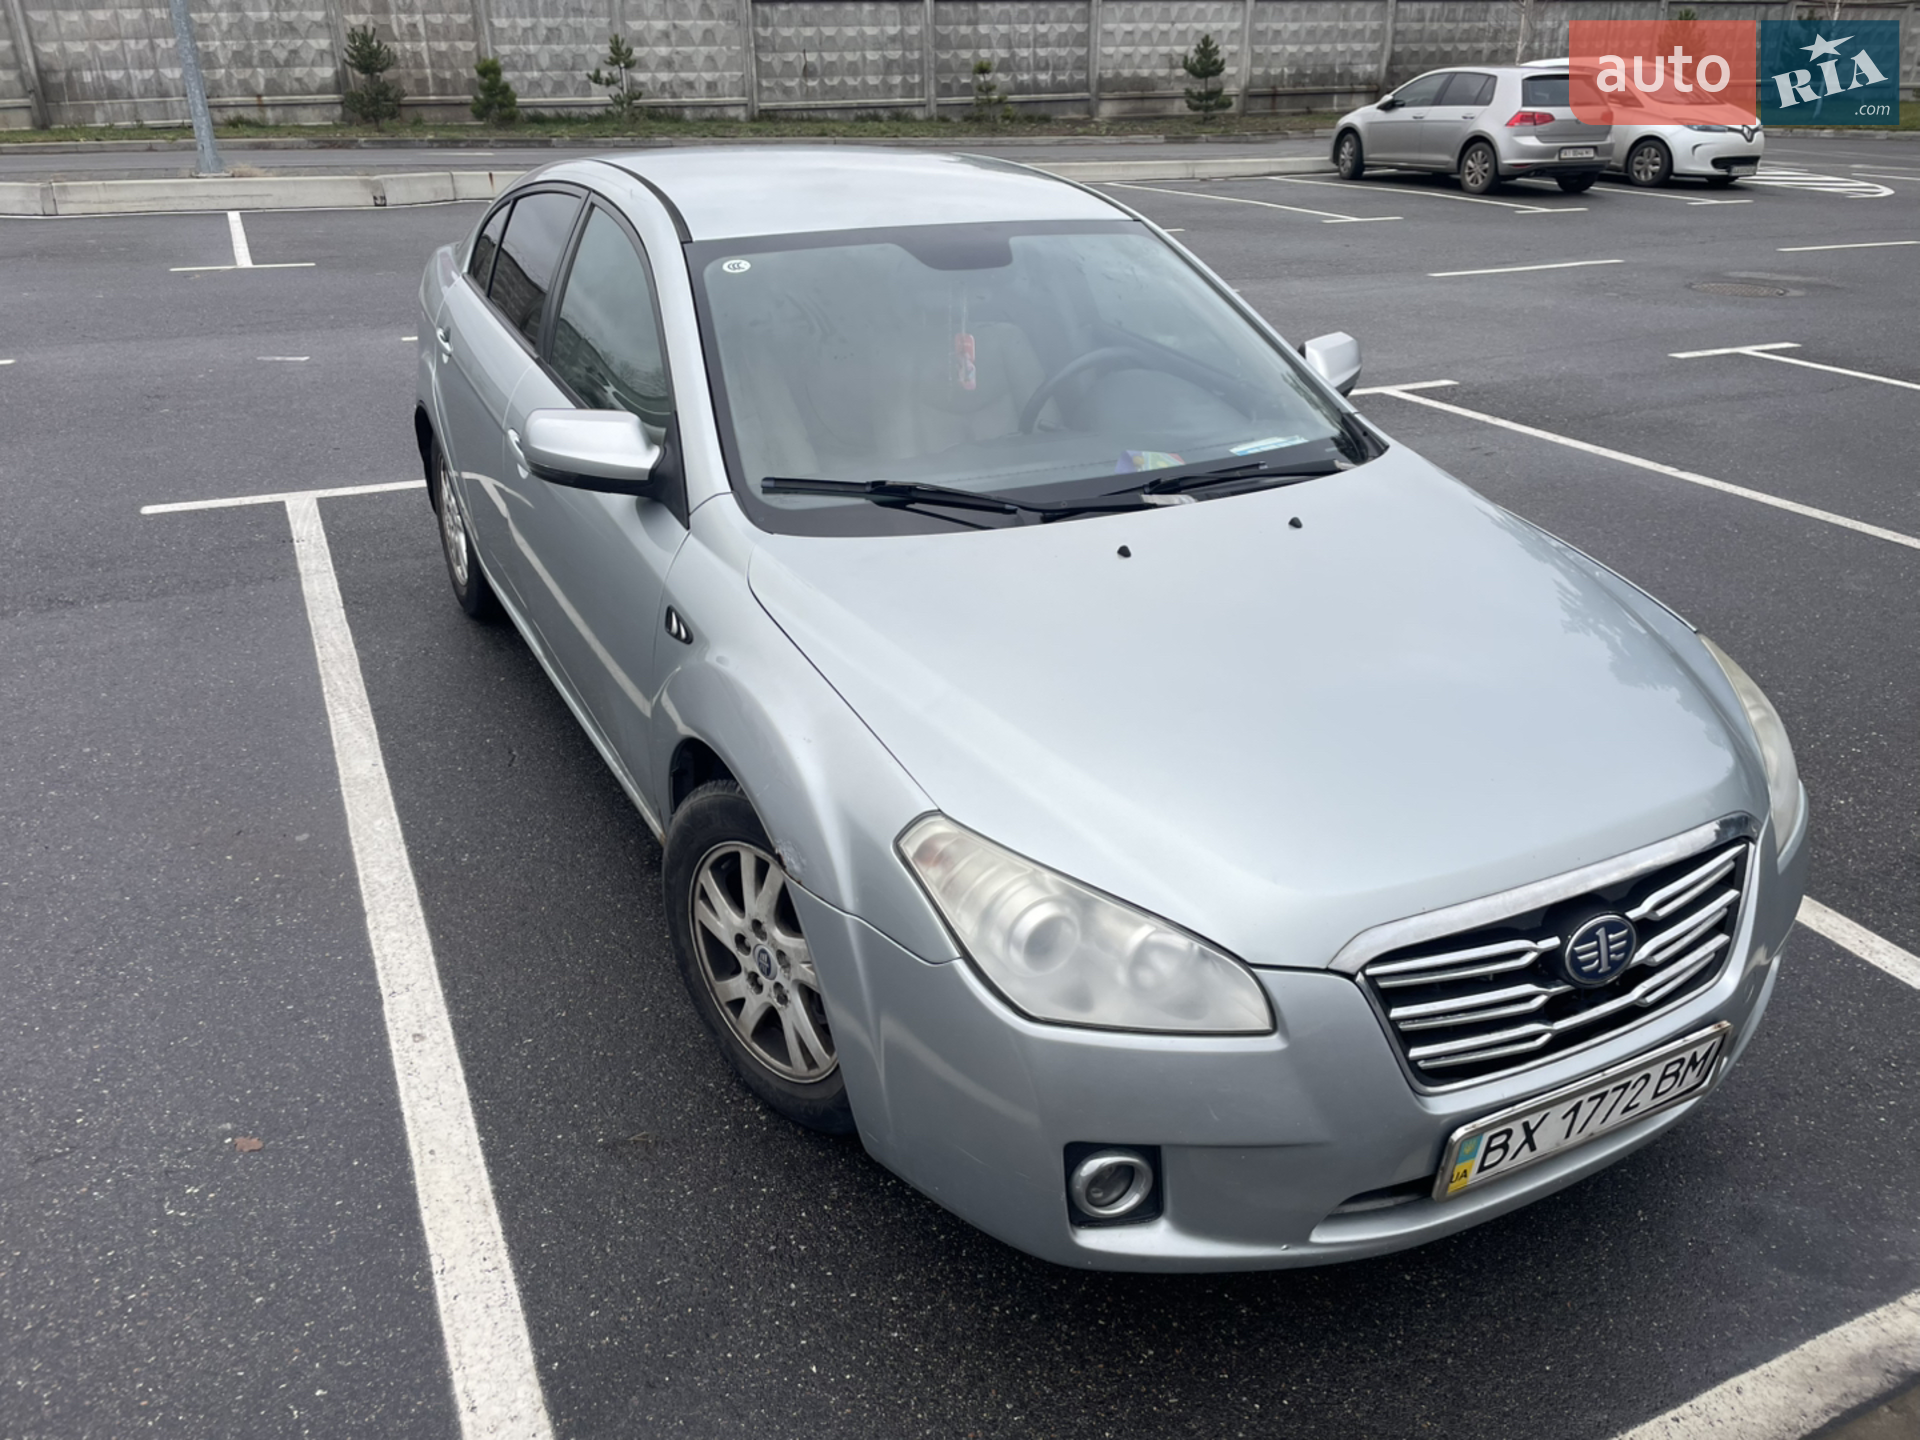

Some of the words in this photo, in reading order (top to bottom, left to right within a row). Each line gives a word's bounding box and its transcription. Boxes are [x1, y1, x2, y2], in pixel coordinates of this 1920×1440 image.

[1476, 1112, 1549, 1174] BX
[1562, 1074, 1651, 1140] 1772
[1651, 1041, 1717, 1100] BM
[1450, 1169, 1468, 1183] UA
